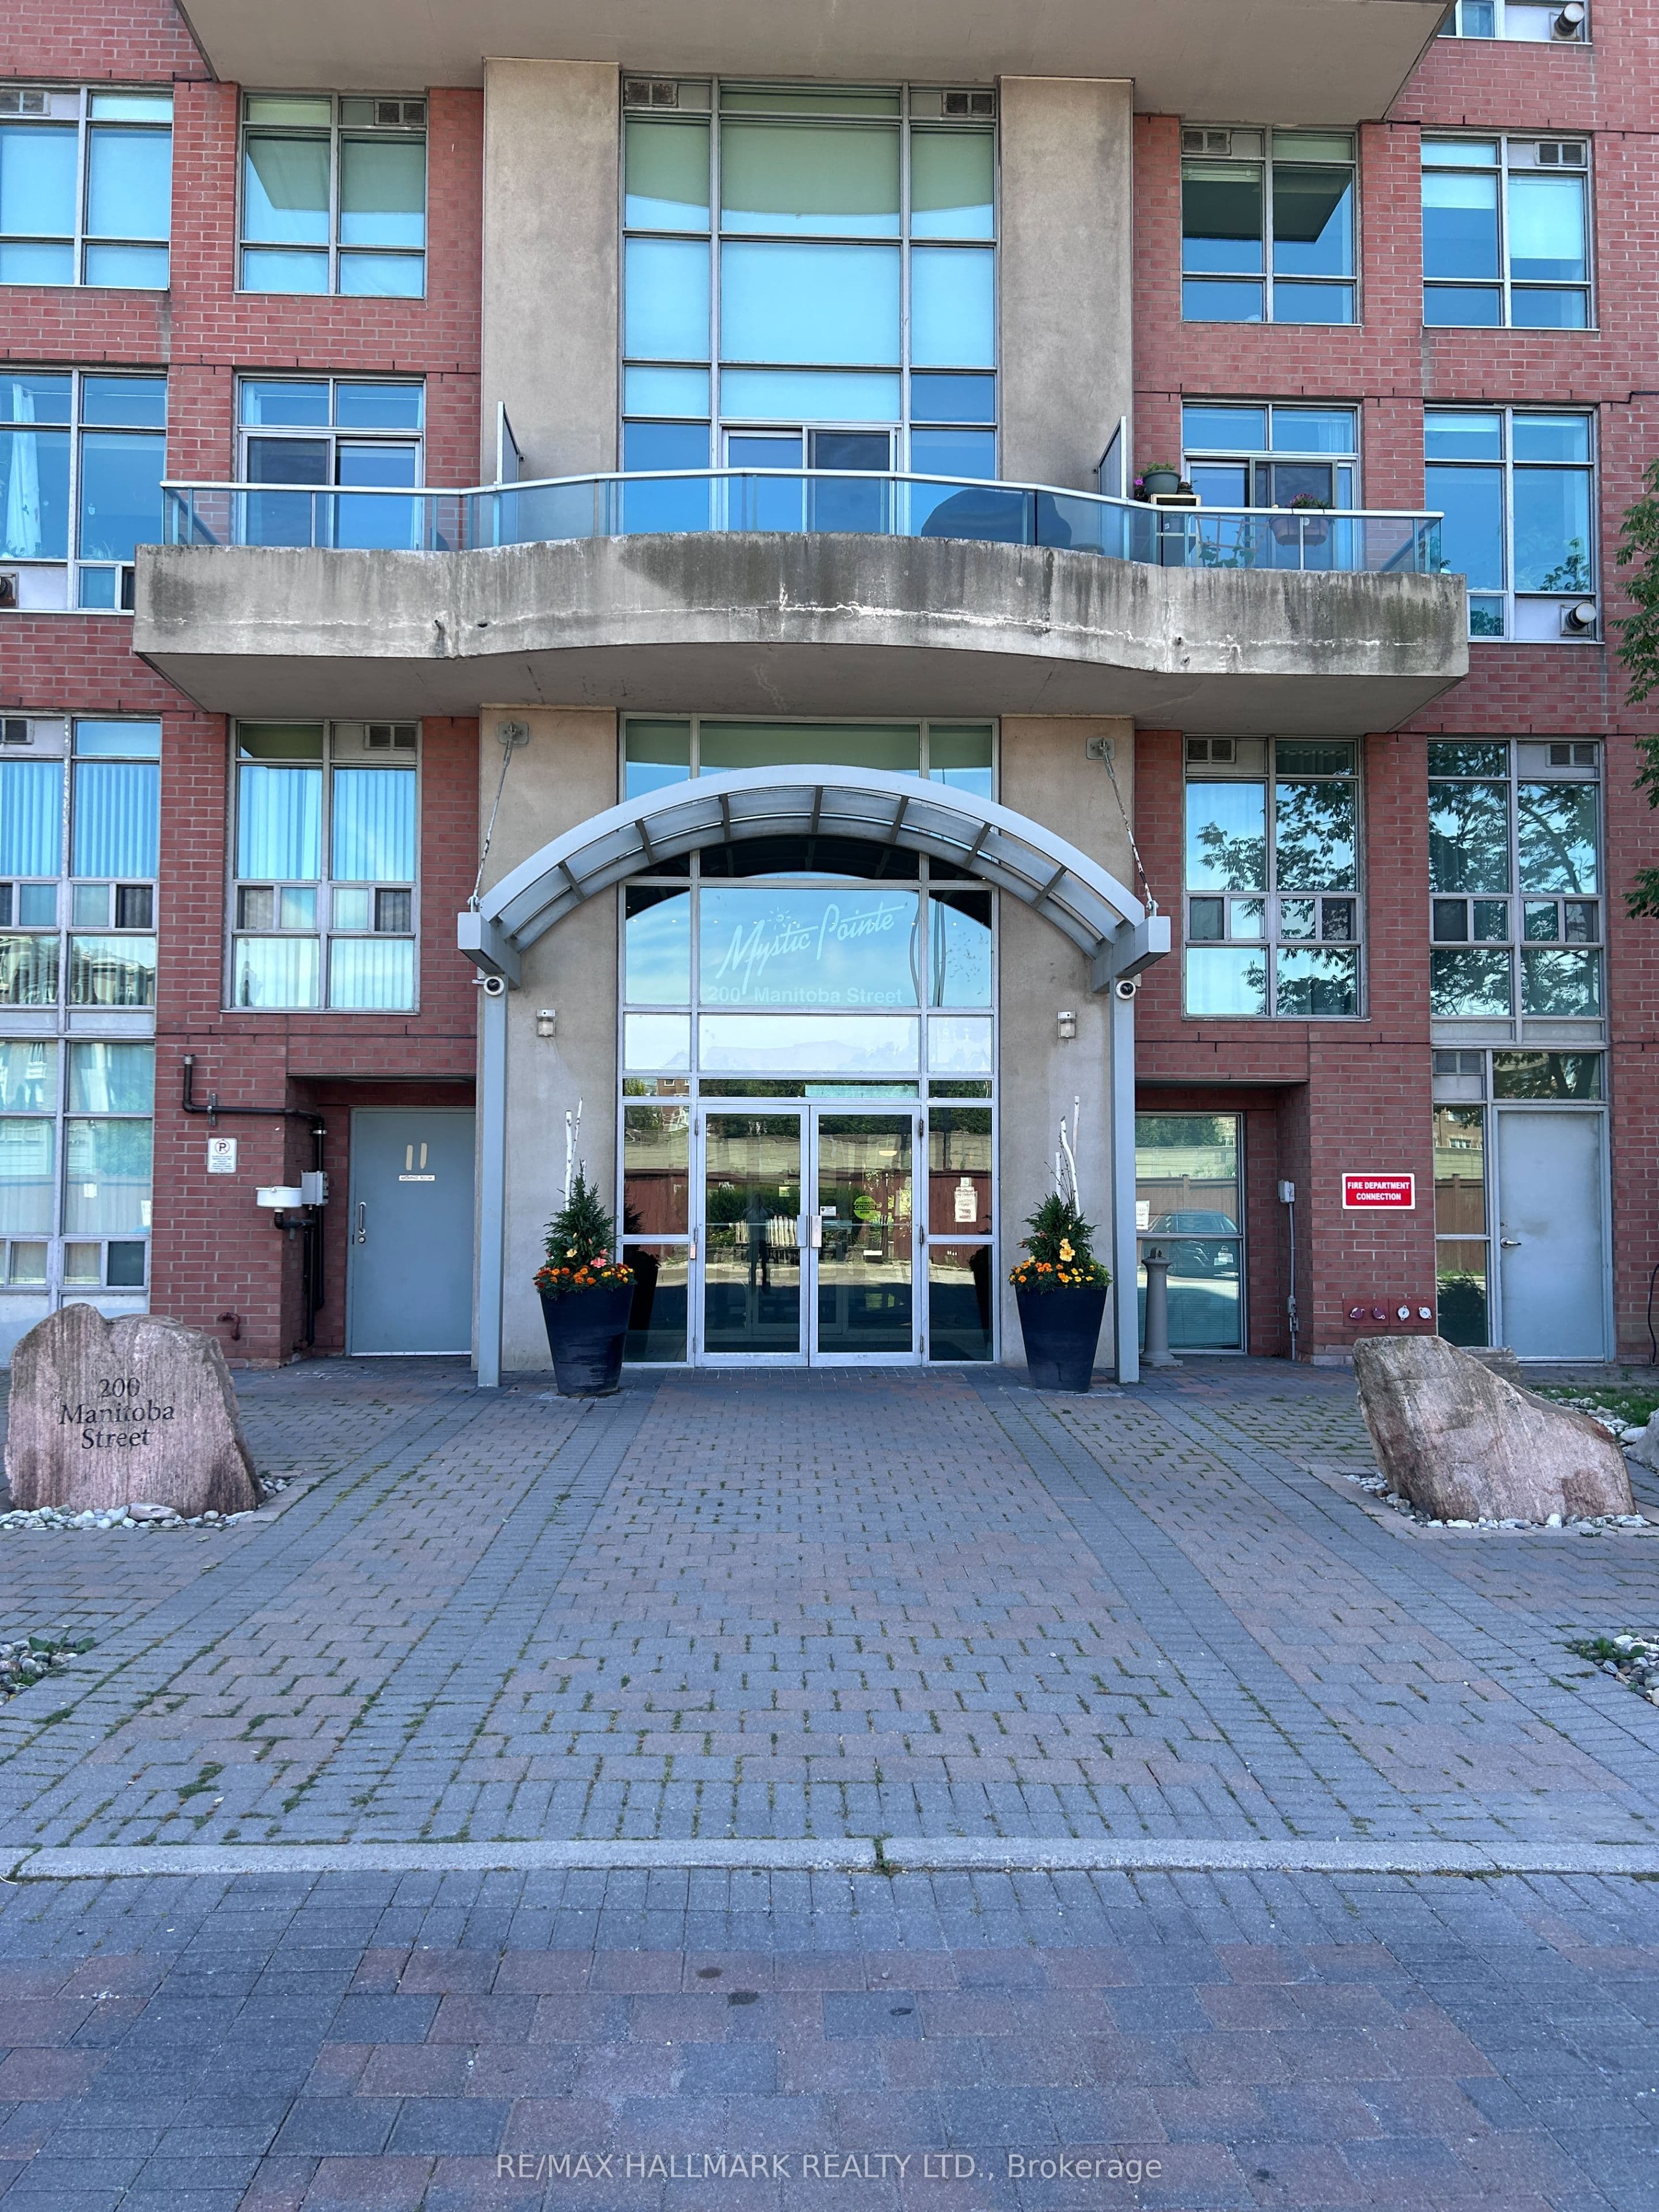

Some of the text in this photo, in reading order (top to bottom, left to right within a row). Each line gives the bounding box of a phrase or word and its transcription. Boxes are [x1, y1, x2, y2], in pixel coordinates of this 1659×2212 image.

[716, 902, 904, 995] Mystic Pointe
[709, 986, 903, 1003] 200 Manitoba Street
[1347, 1181, 1410, 1190] FIRE DEPARTMENT
[1356, 1192, 1402, 1200] CONNECTION
[99, 1377, 141, 1398] 200
[59, 1399, 175, 1425] Manitoba
[82, 1427, 151, 1450] Street
